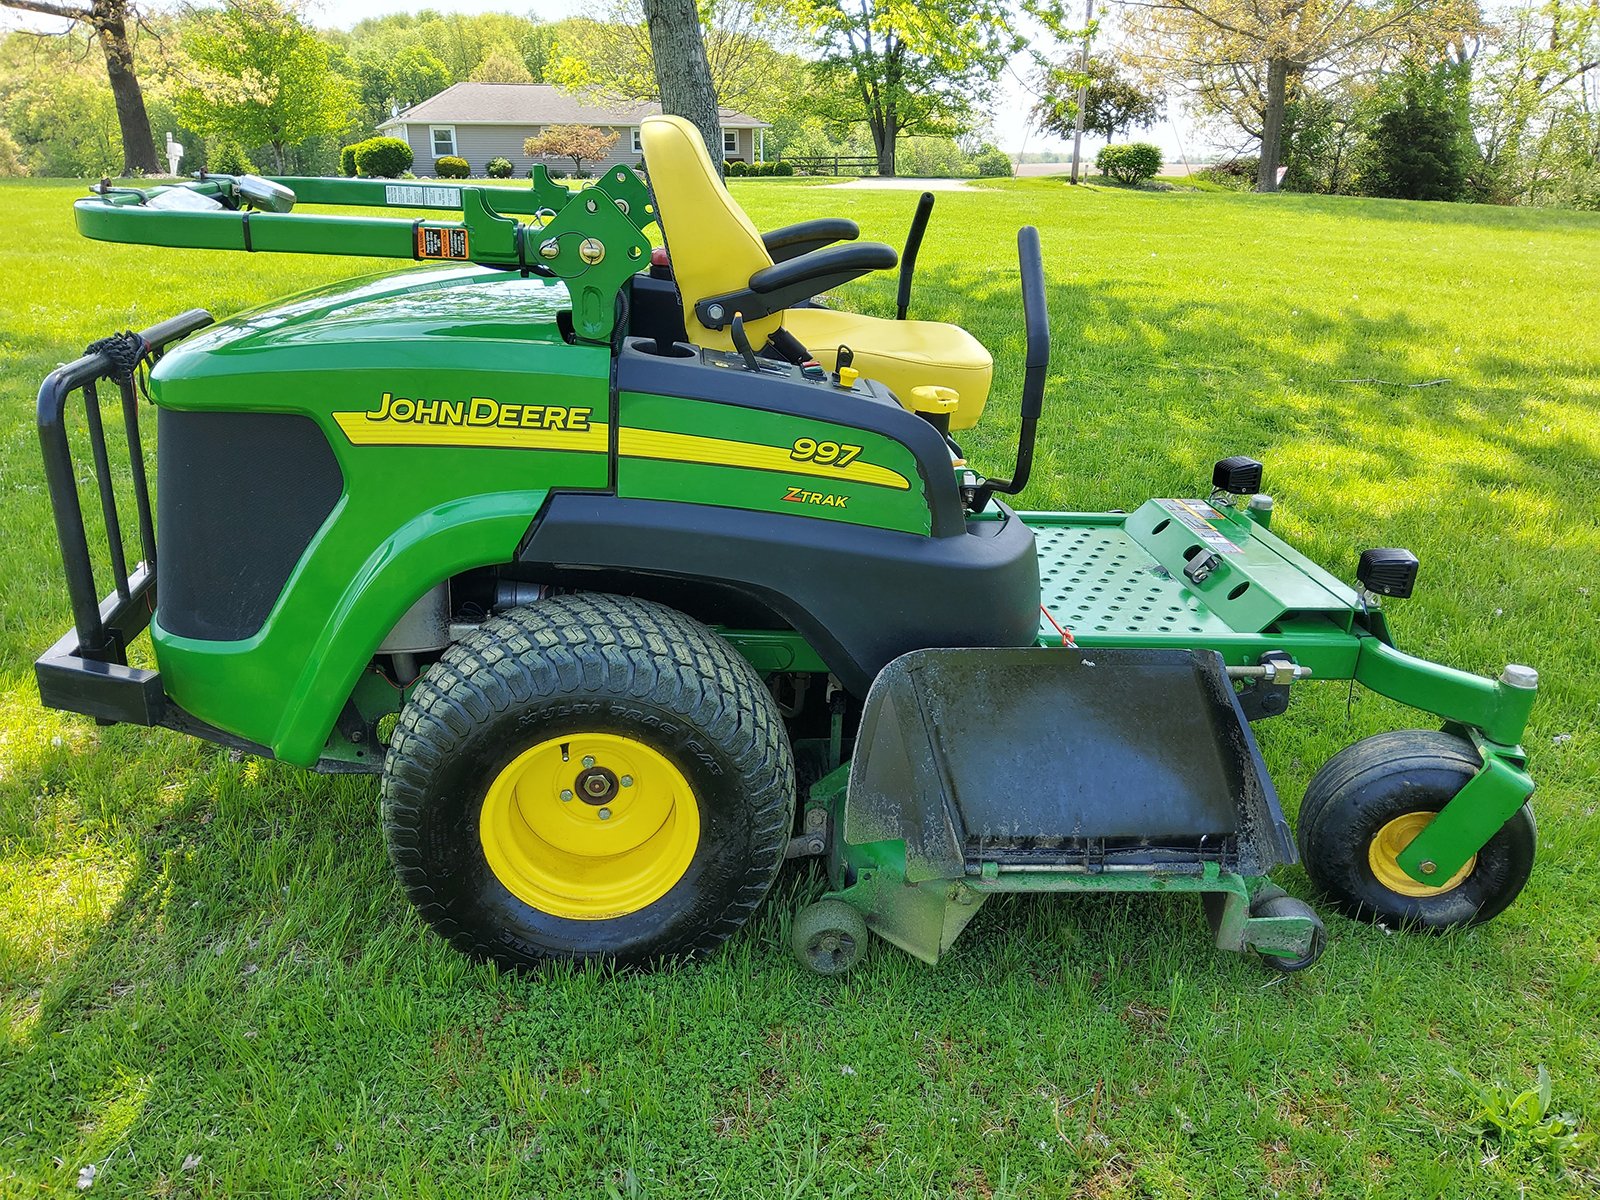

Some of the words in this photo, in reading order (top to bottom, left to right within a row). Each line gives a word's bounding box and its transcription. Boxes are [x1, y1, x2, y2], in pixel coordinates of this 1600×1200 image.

[366, 392, 465, 425] JOHN
[466, 397, 592, 431] DEERE
[790, 437, 864, 468] 997
[781, 486, 850, 509] ZTRAK
